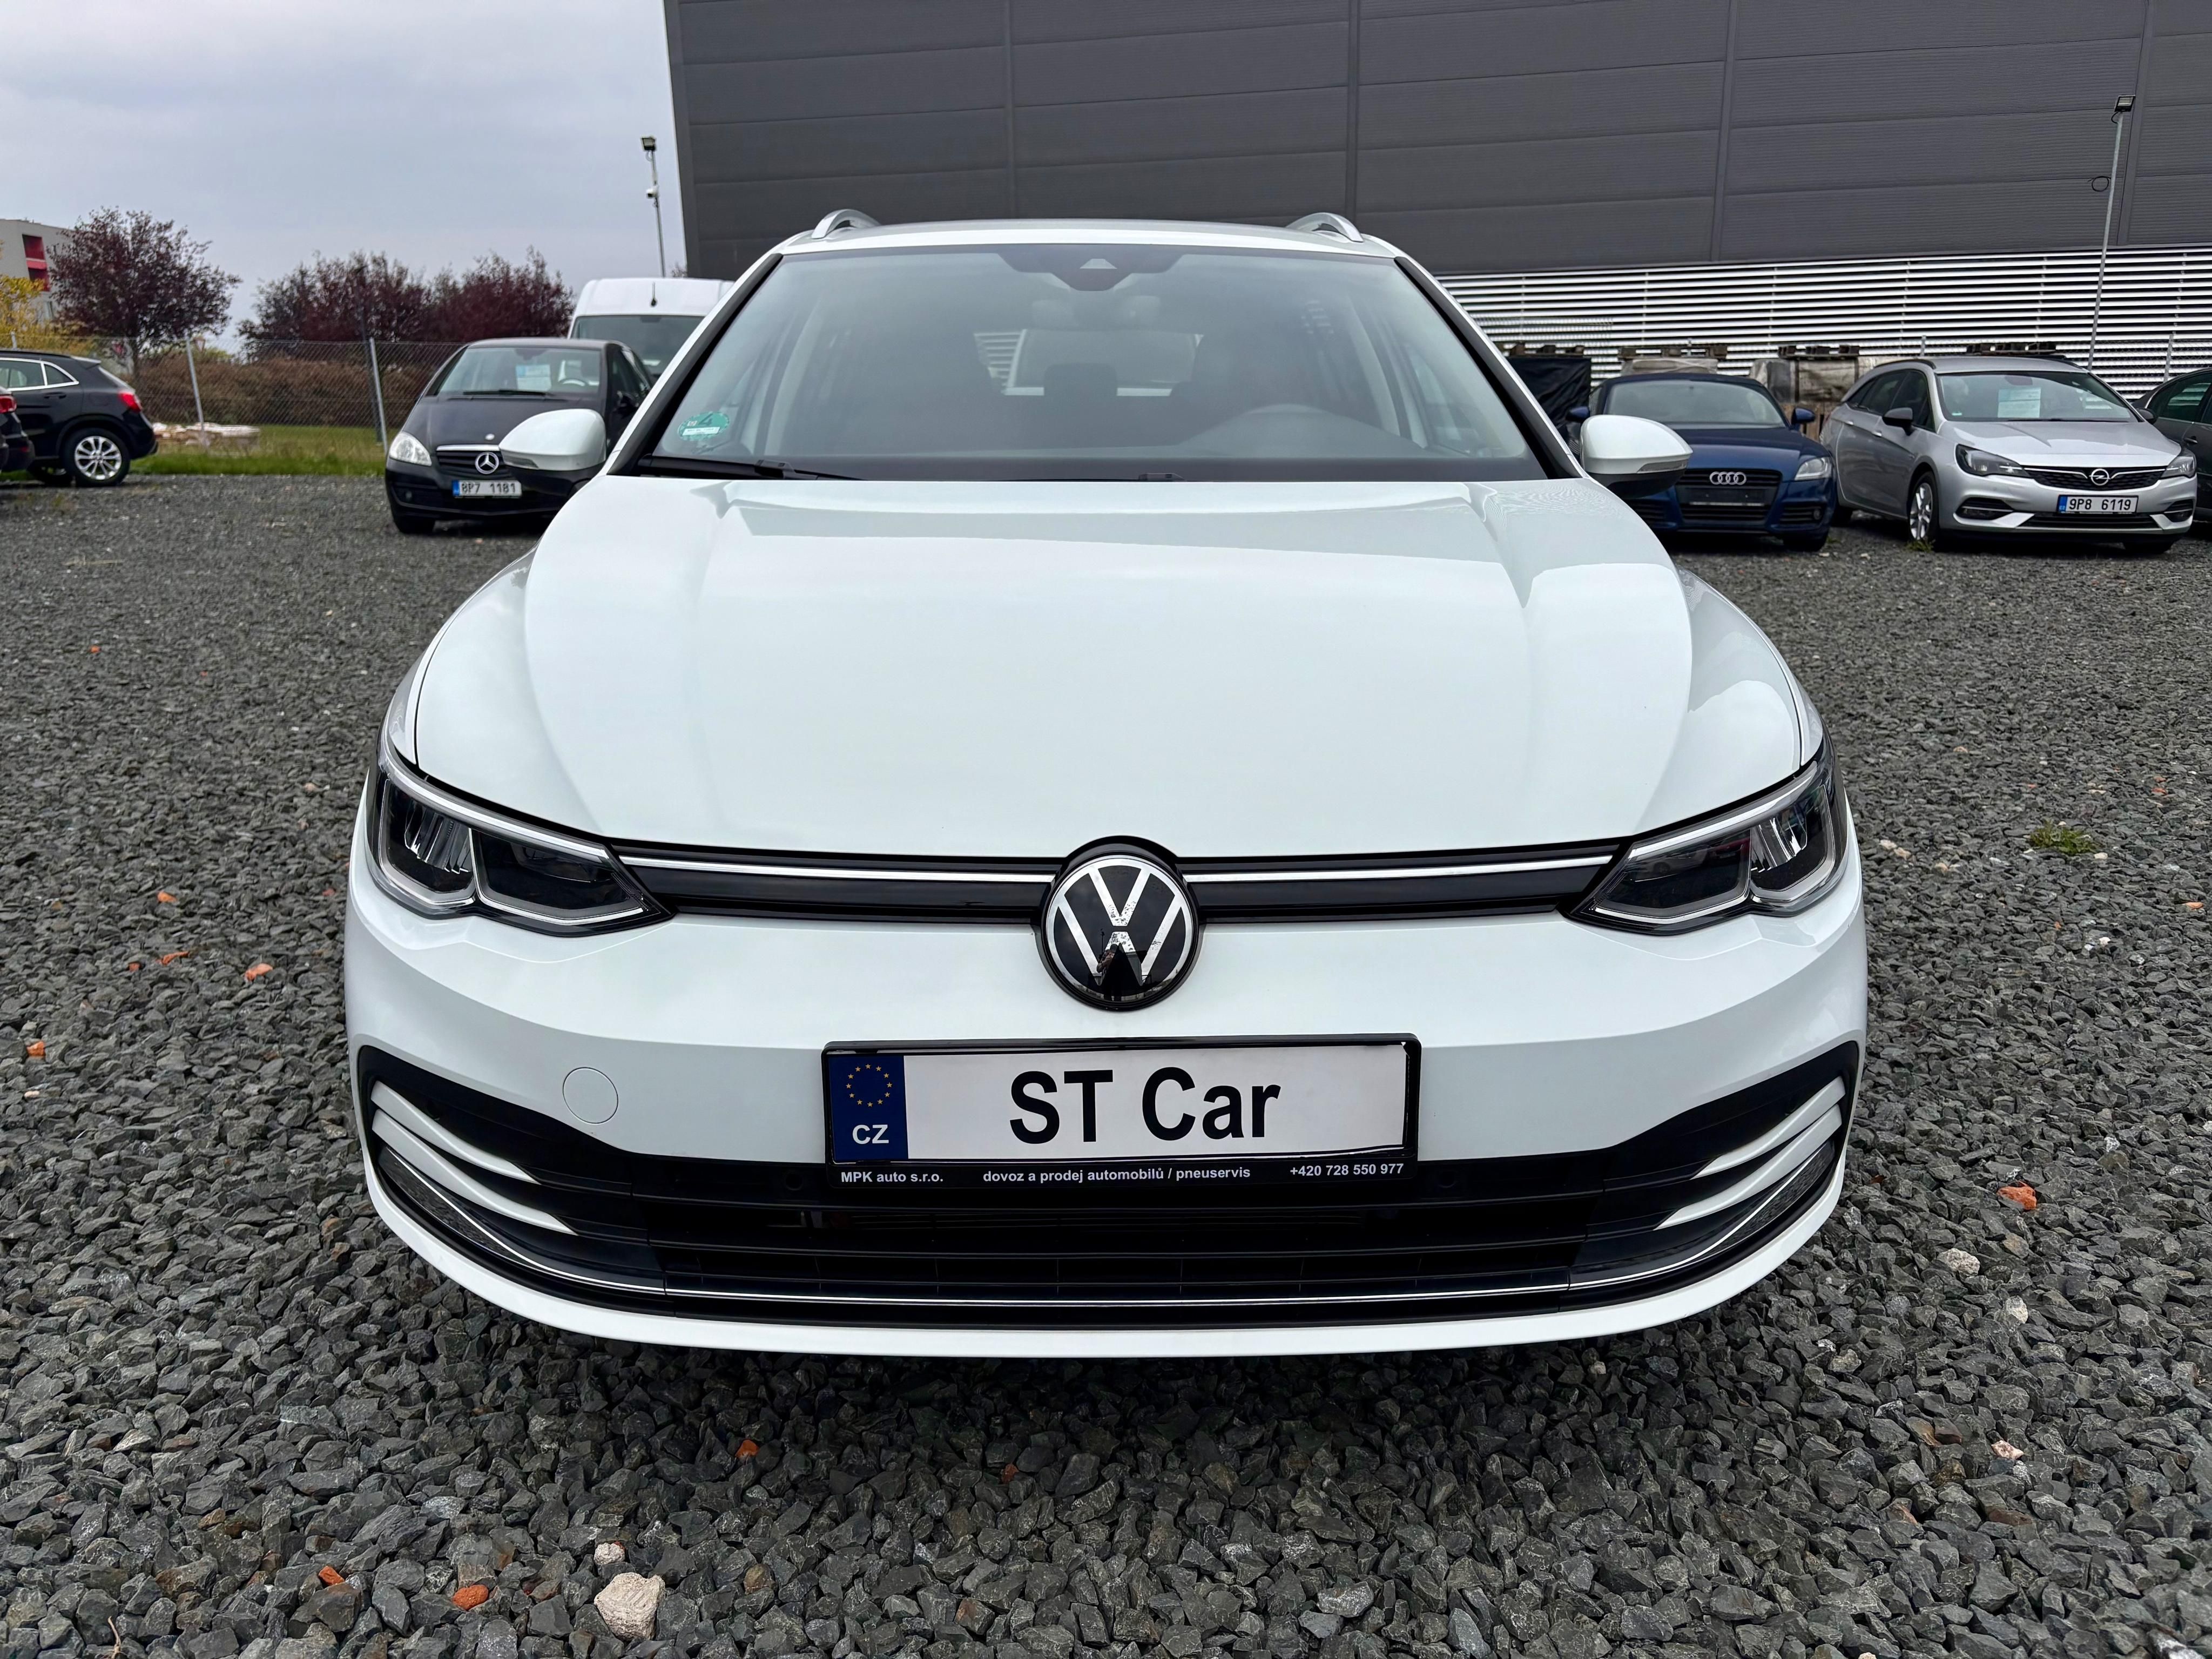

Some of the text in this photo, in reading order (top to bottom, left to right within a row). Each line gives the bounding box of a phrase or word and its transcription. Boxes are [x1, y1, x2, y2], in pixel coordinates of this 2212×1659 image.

[698, 414, 713, 426] 4
[462, 483, 516, 494] 8P7 1181
[2069, 498, 2131, 510] 9P8 6119
[1009, 1067, 1281, 1144] ST Car
[852, 1124, 889, 1144] CZ
[983, 1166, 1251, 1184] dovoz a prodej automobilů / pneuservis
[1290, 1163, 1404, 1176] +420 728 550 977
[841, 1171, 943, 1183] MPK auto s.r.o.
